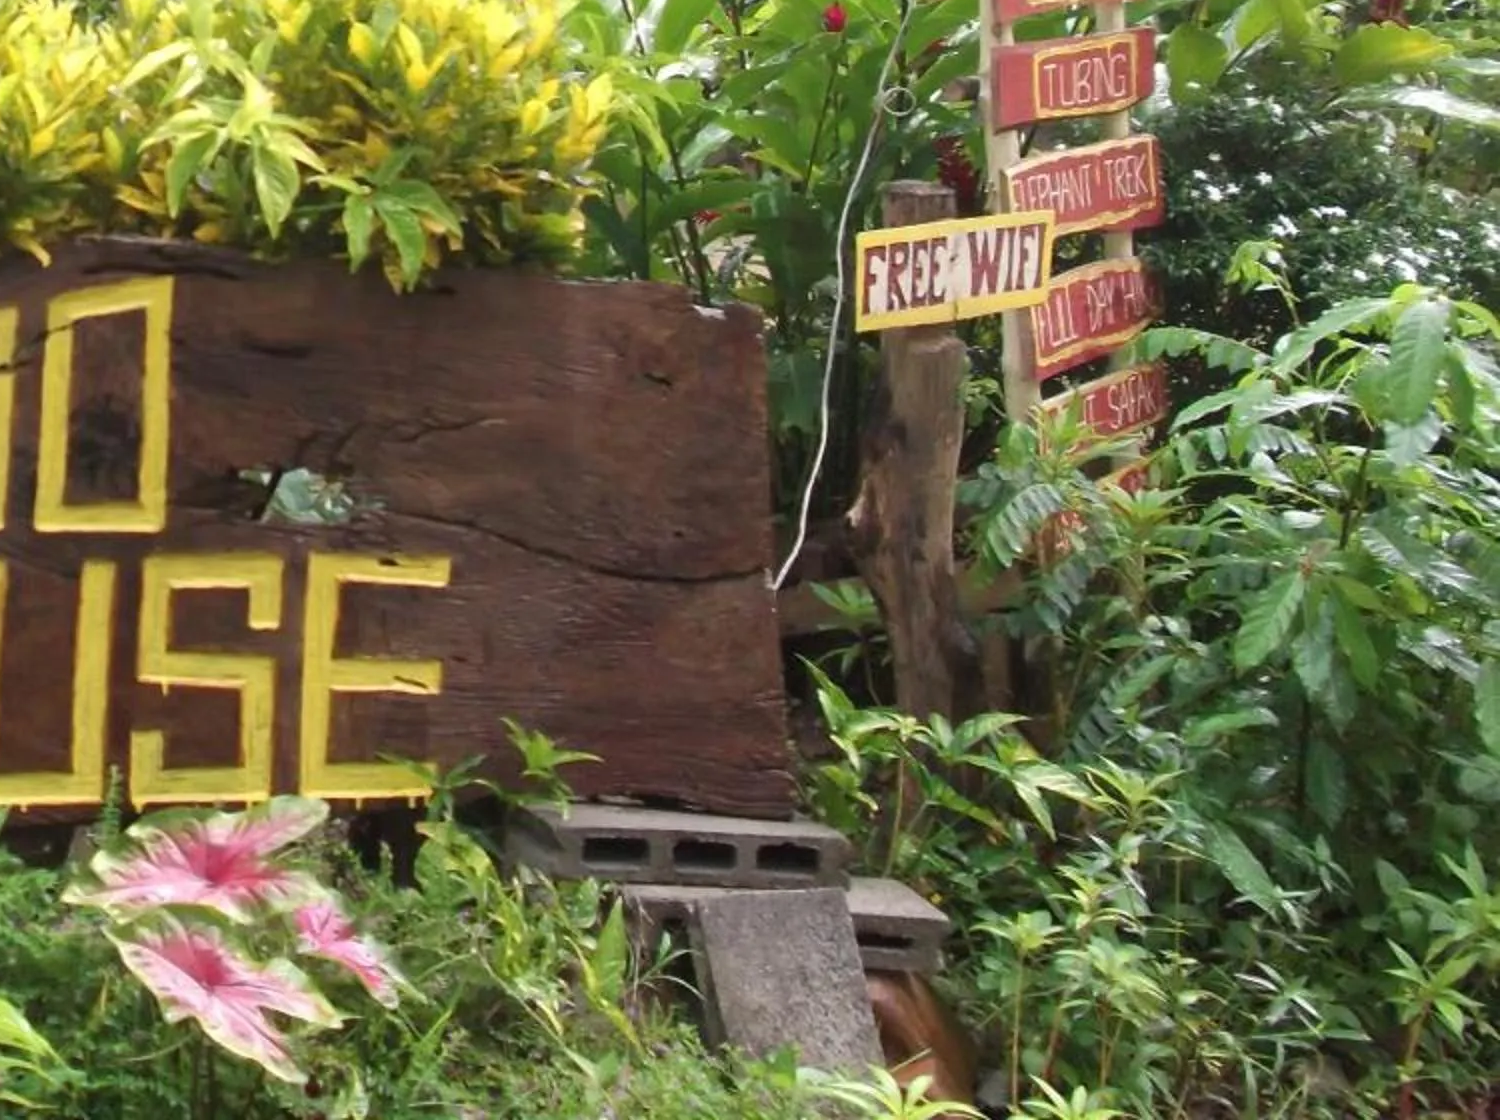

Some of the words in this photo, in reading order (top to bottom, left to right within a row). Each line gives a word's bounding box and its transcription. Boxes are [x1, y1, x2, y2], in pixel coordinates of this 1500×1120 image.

[1043, 53, 1128, 107] TUBING
[1012, 164, 1093, 214] ELEPHANT
[1103, 154, 1149, 201] TREK
[862, 237, 949, 316] FREE
[967, 221, 1047, 297] WIFI
